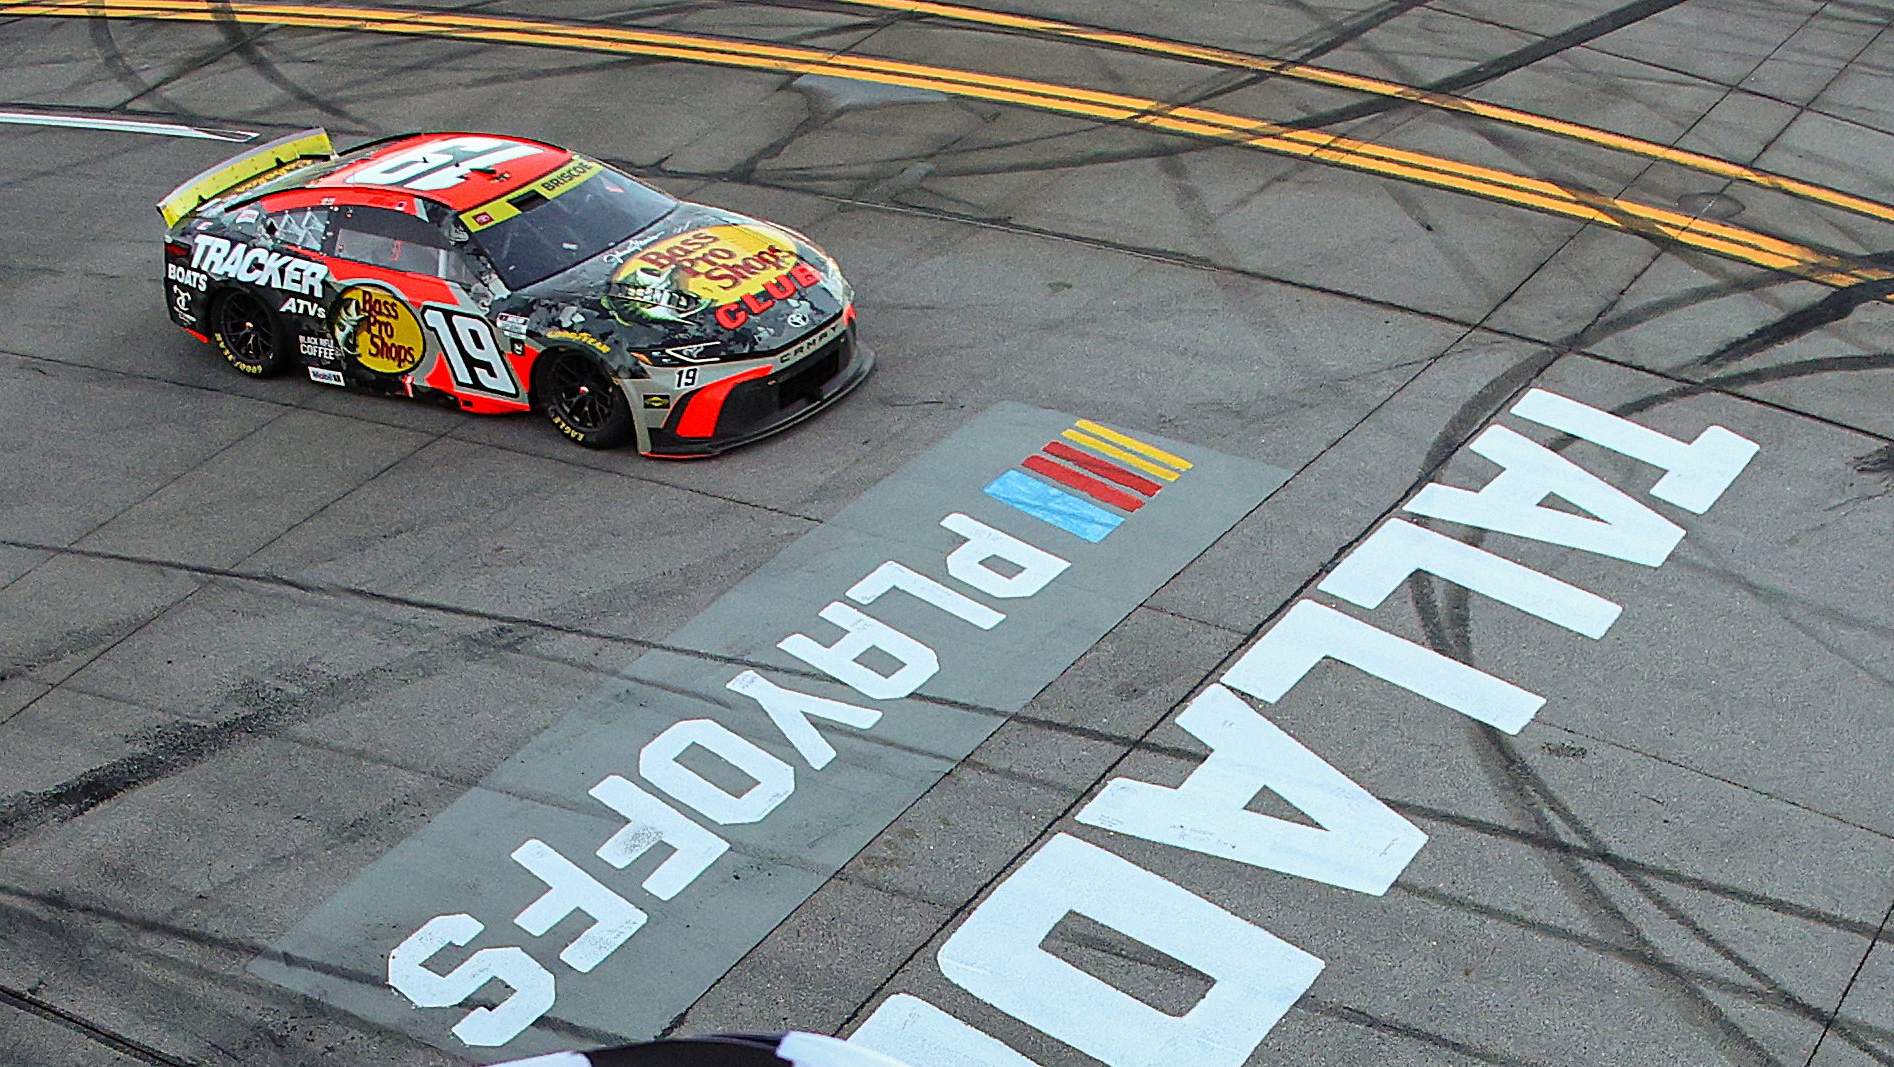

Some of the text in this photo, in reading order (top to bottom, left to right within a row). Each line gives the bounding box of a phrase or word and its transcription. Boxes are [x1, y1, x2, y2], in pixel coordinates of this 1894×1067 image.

[540, 161, 593, 192] BRISCOE
[190, 233, 329, 299] TRACKER
[639, 231, 721, 270] Bass
[682, 247, 736, 278] Pro
[167, 263, 207, 292] BOATS
[707, 244, 794, 291] Shops
[279, 297, 327, 319] ATVs
[359, 290, 399, 319] Bass
[713, 264, 823, 331] CLUB
[366, 312, 394, 341] Pro
[367, 335, 416, 368] Shops
[421, 306, 520, 396] 19
[780, 325, 839, 365] CAMRY
[675, 368, 698, 389] 19
[388, 511, 1072, 1047] PLAYOFFS
